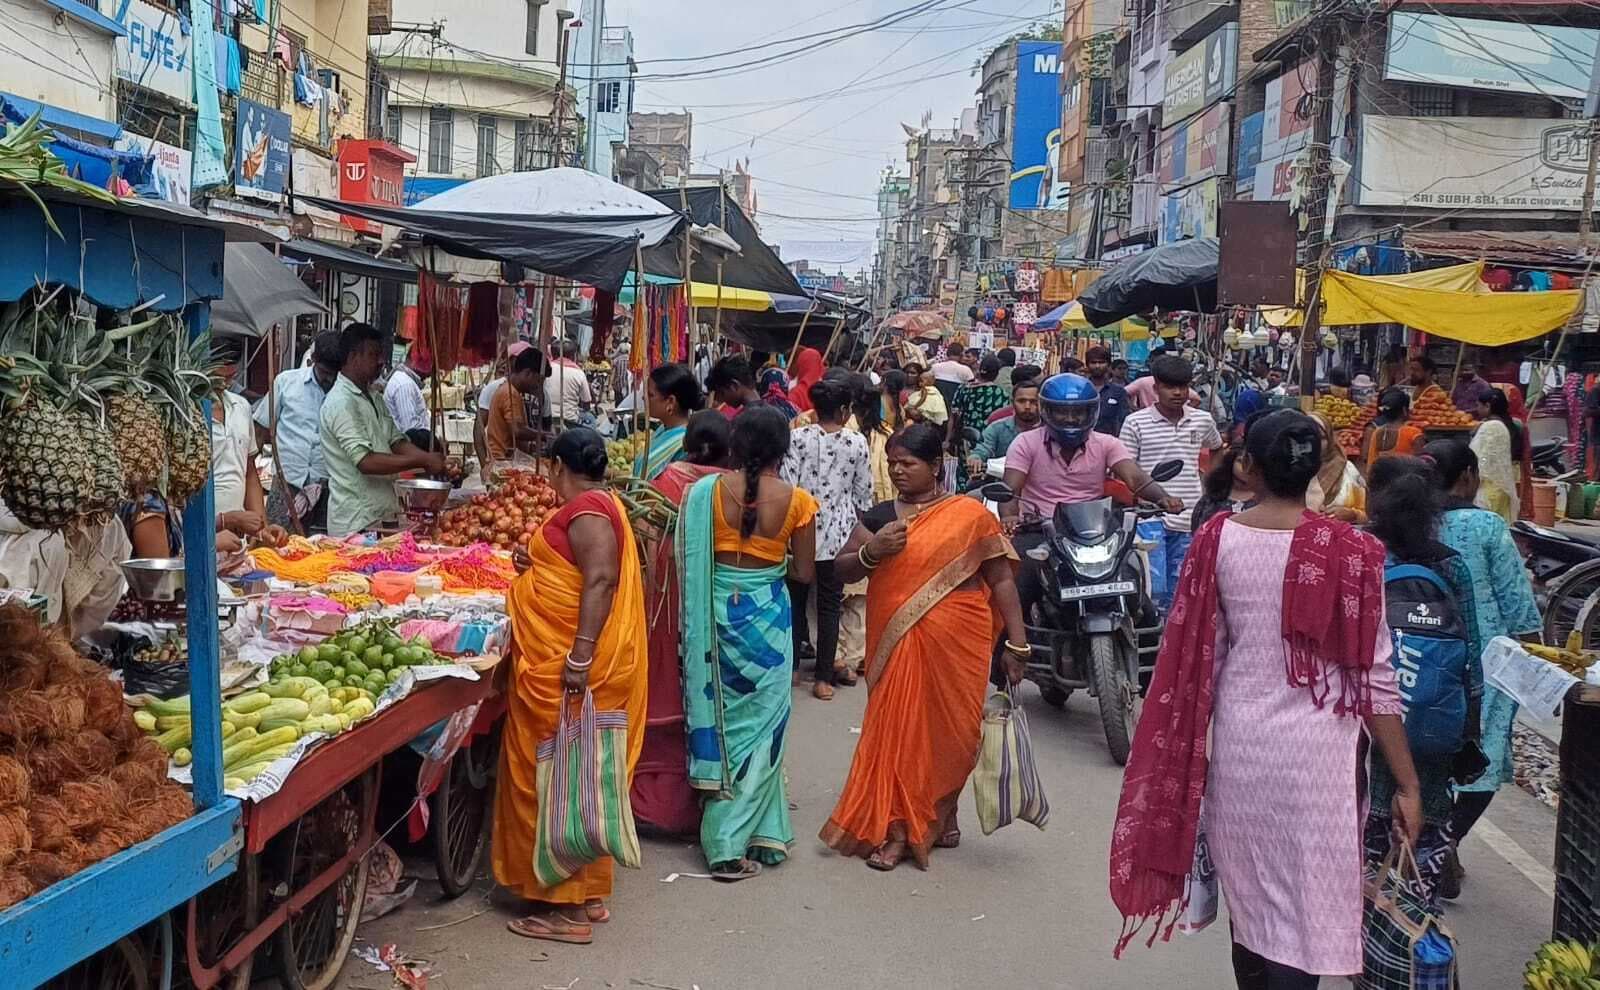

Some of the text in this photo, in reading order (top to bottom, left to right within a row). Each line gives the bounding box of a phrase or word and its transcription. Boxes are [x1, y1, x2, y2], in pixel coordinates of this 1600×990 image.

[1413, 193, 1433, 203] SRI
[1437, 194, 1471, 204] SUBH
[1408, 612, 1441, 626] ferrari
